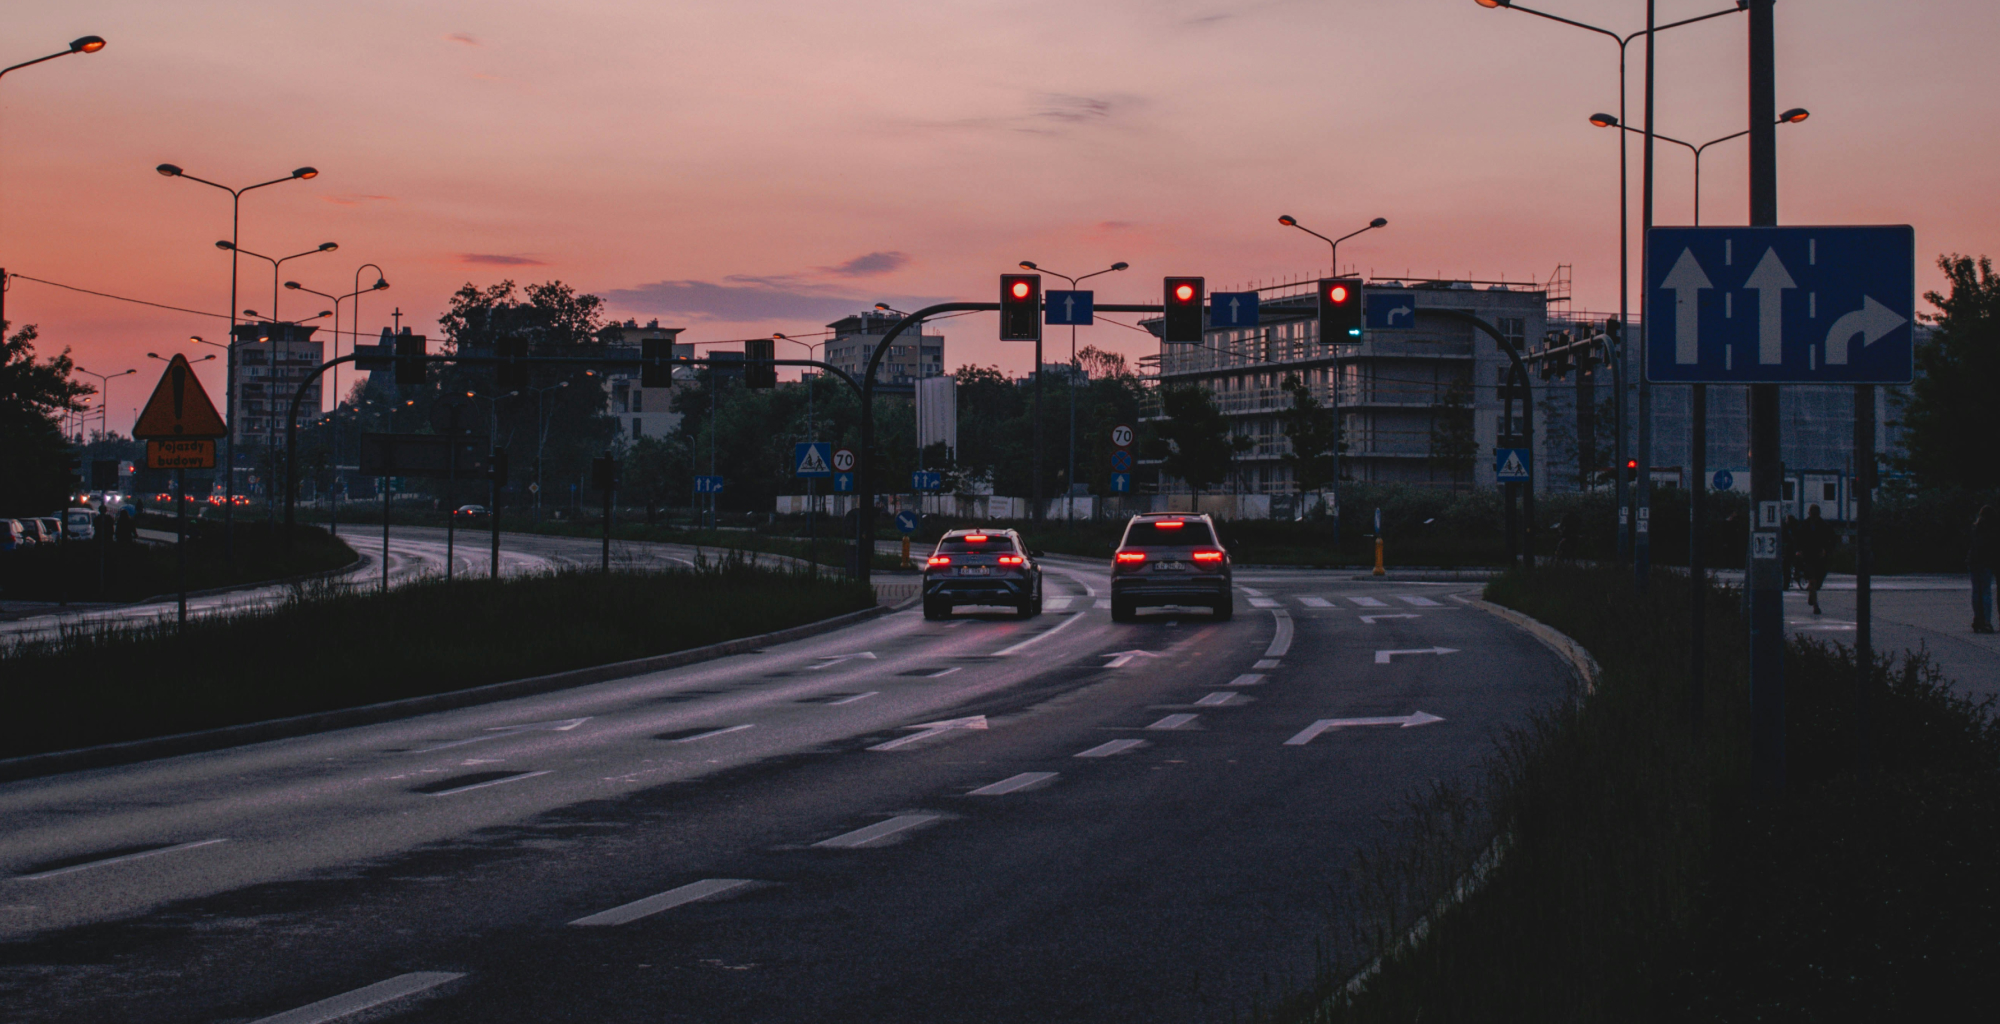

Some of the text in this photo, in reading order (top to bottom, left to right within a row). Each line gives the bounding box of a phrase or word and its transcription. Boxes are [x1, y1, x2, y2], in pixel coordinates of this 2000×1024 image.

[1115, 430, 1132, 442] 70
[158, 440, 204, 454] Pojazdy
[158, 455, 204, 467] budowy
[836, 454, 853, 466] 70
